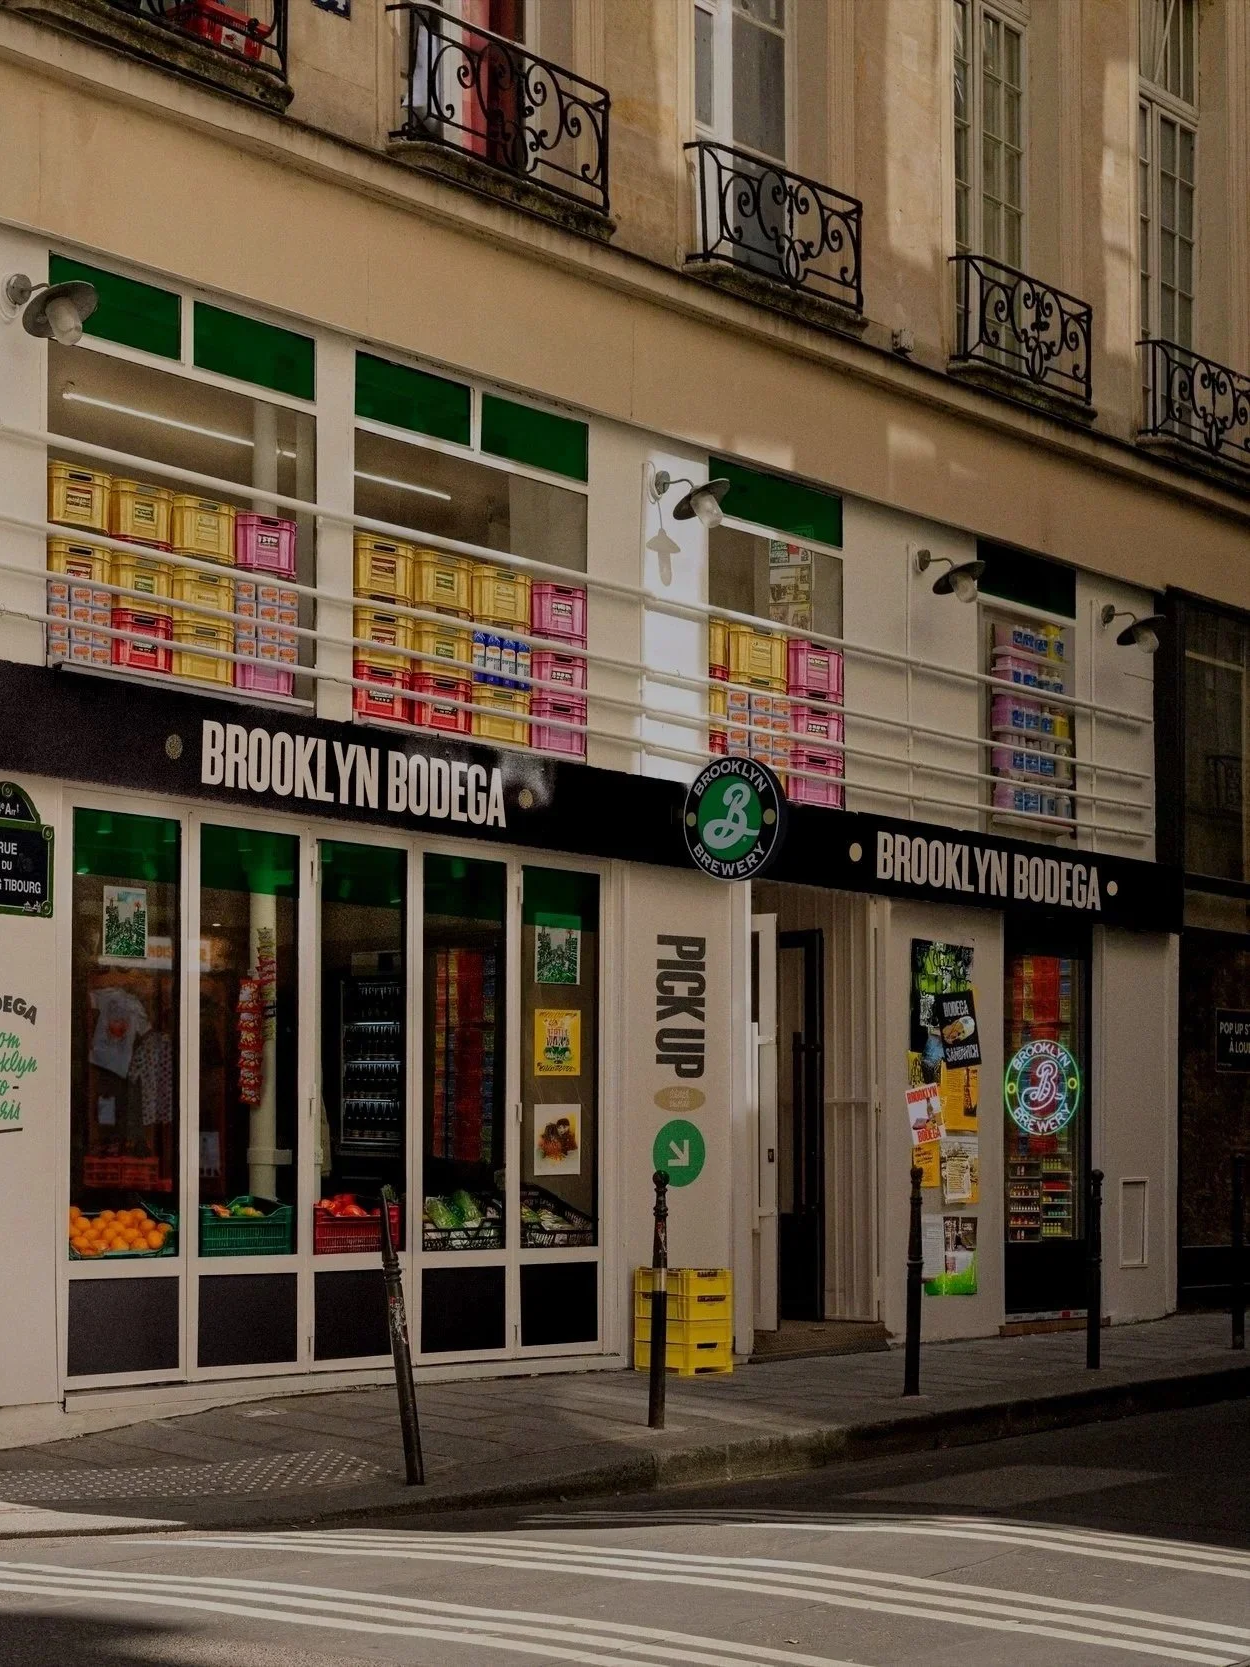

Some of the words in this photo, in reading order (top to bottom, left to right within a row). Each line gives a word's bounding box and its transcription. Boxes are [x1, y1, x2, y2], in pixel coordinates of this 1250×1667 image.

[201, 719, 379, 808] BROOKLYN
[387, 751, 506, 828] BODEGA
[693, 760, 767, 797] BROOKLYN
[1, 860, 12, 871] DU
[693, 841, 765, 876] BREWERY
[876, 831, 1007, 897] BROOKLYN
[1014, 855, 1101, 911] BODEGA
[4, 878, 41, 894] TIBOURG
[655, 934, 706, 1023] PICK
[943, 1000, 969, 1018] BODEGA
[1219, 1021, 1234, 1035] POP
[1234, 1021, 1244, 1036] UP
[655, 1028, 705, 1078] UP
[945, 1044, 980, 1063] SANDWICH
[1013, 1043, 1070, 1071] BROOKLYN
[906, 1085, 938, 1104] BROOKLYN
[1013, 1103, 1070, 1132] BREWERY
[917, 1126, 942, 1144] BODEGA
